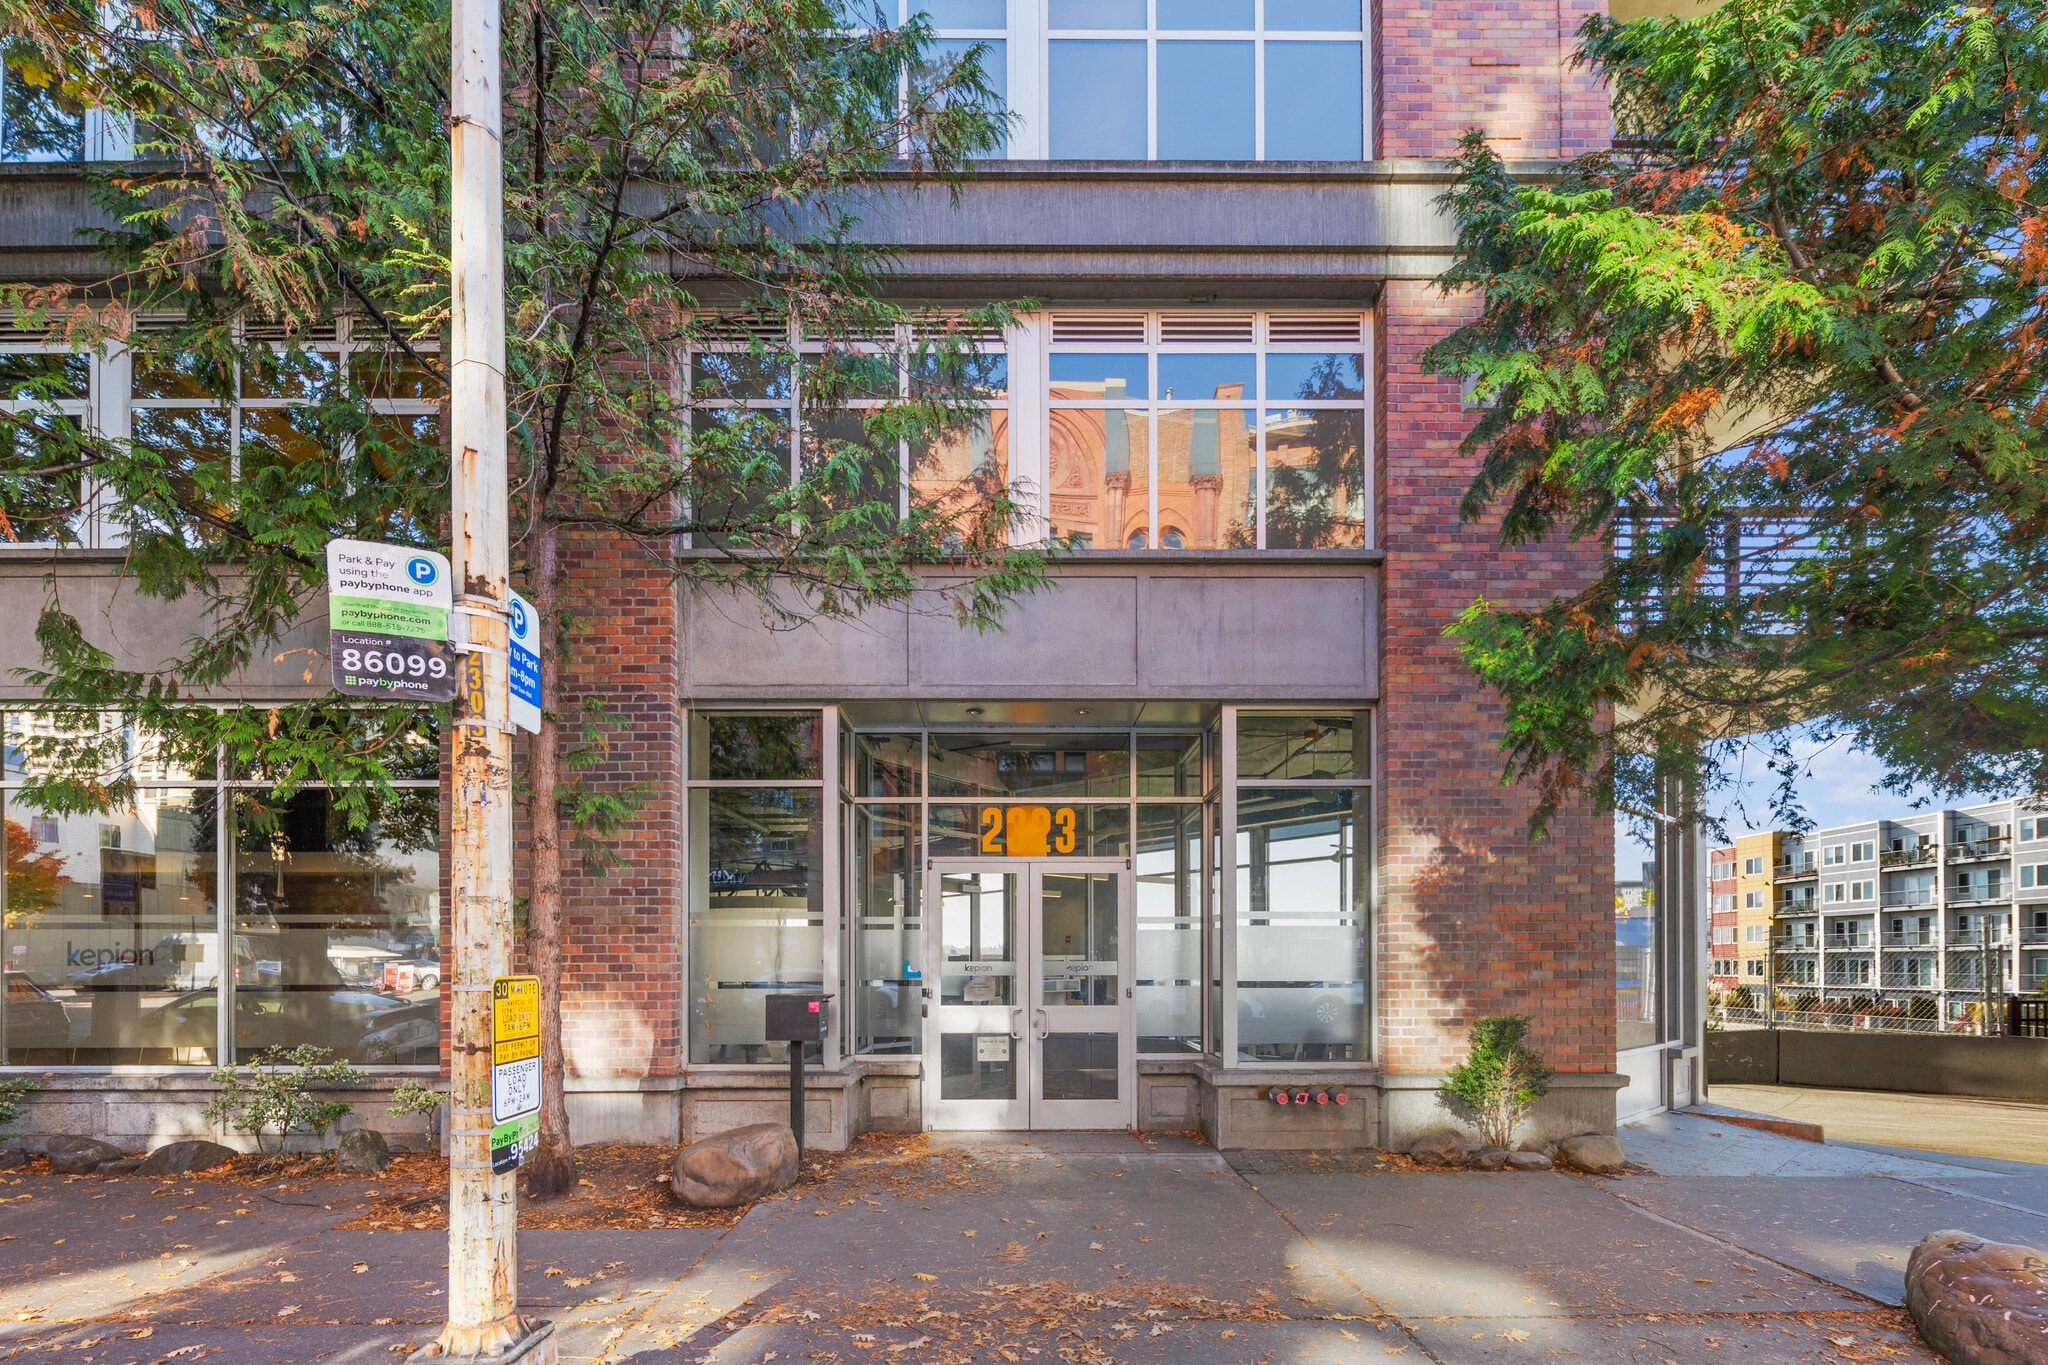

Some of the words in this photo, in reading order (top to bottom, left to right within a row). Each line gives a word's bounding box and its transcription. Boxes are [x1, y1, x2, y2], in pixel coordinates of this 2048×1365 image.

[338, 553, 363, 565] Park
[364, 557, 373, 566] &
[375, 558, 396, 570] Pay
[339, 567, 368, 579] using
[370, 569, 389, 579] the
[340, 580, 411, 594] paybyphone
[413, 588, 434, 598] app
[341, 609, 432, 625] paybyphone.com
[351, 619, 366, 627] call
[366, 620, 426, 634] 888-515-7275
[342, 635, 384, 647] Location
[341, 648, 448, 680] 86099
[512, 647, 521, 662] to
[521, 652, 539, 674] Park
[358, 676, 429, 690] paybyphone
[66, 940, 155, 971] kepion
[964, 963, 993, 974] kepion
[495, 982, 508, 997] 30
[502, 1013, 518, 1024] LOAD
[511, 1040, 528, 1051] PERMIT
[500, 1052, 509, 1062] PAY
[520, 1047, 535, 1057] PHONE
[498, 1061, 537, 1079] PASSENGER
[507, 1073, 528, 1087] LOAD
[508, 1083, 527, 1096] ONLY
[492, 1158, 508, 1169] Location
[509, 1131, 539, 1161] 95424
